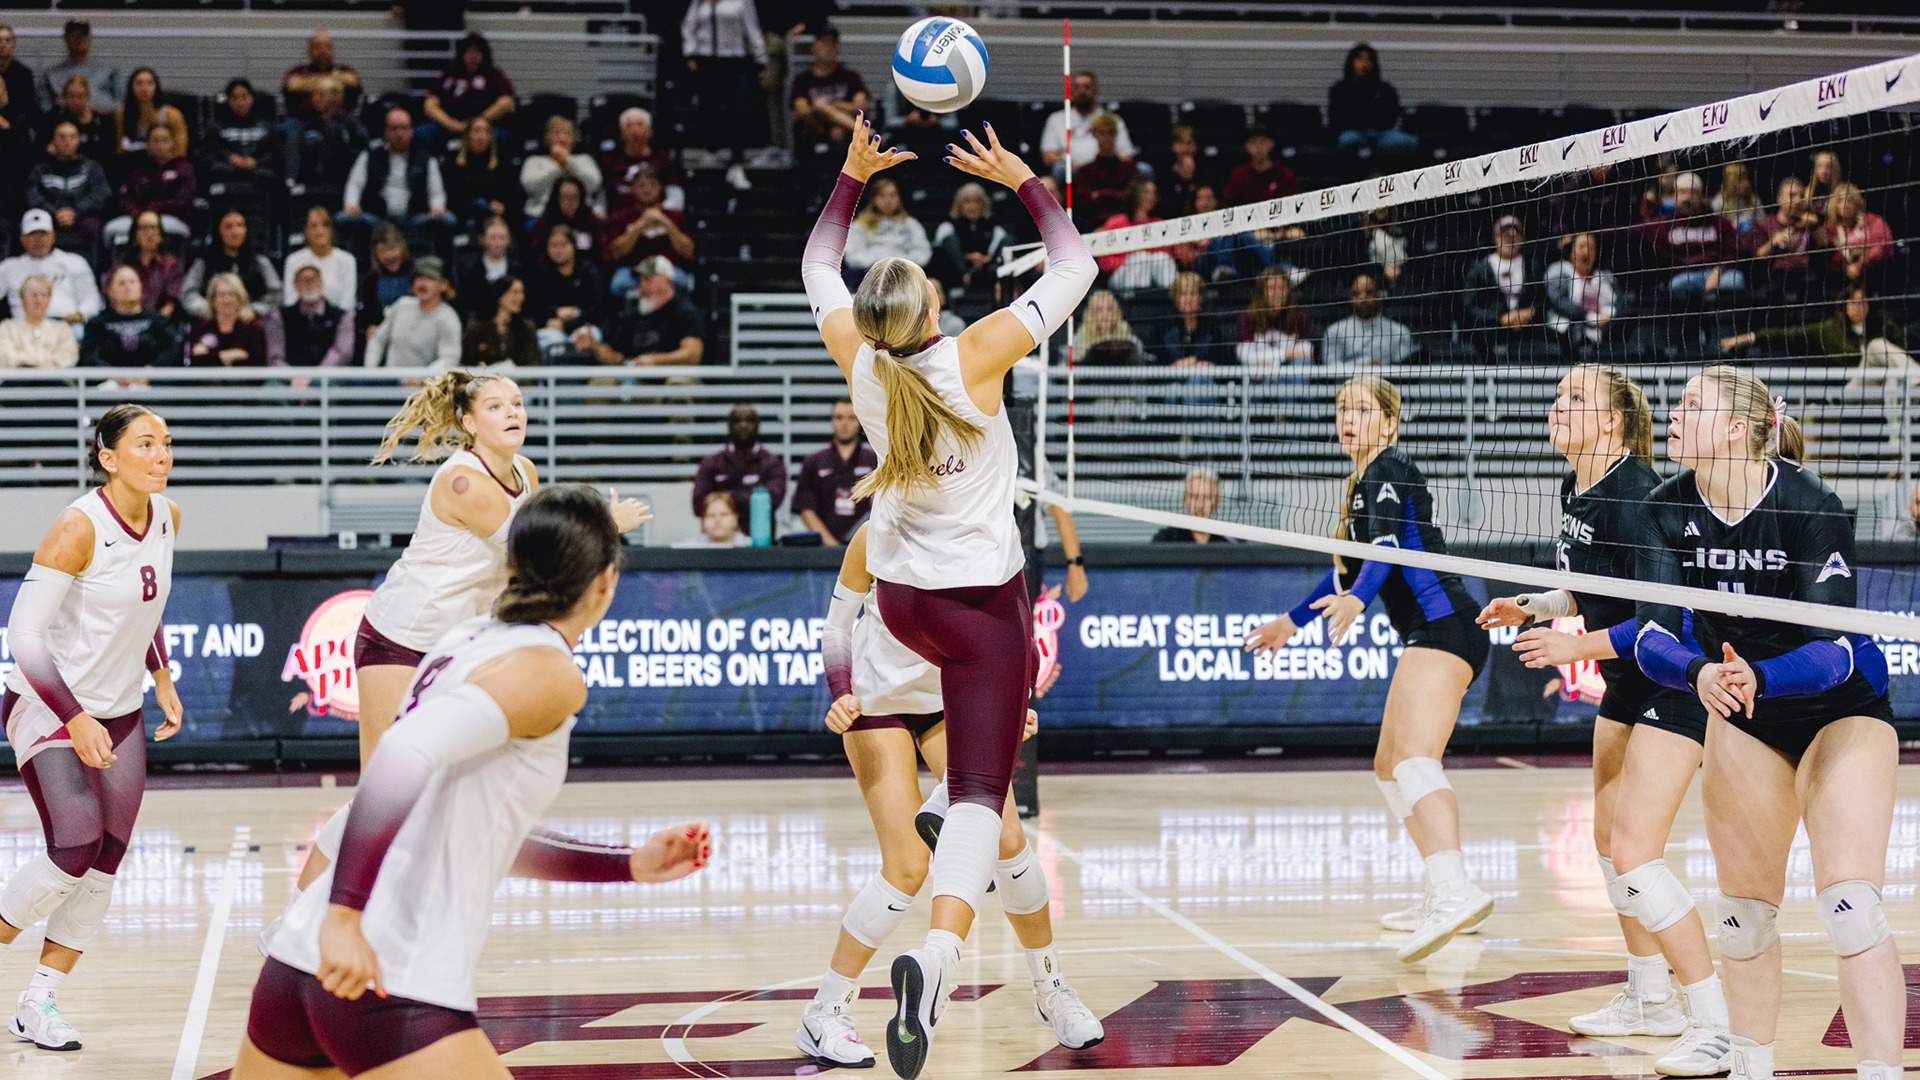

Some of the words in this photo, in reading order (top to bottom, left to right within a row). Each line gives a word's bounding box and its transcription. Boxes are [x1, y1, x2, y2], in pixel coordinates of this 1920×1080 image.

[1519, 144, 1540, 166] EKU
[1602, 124, 1627, 147] EKU
[1702, 103, 1729, 128] EKU
[1818, 75, 1847, 102] EKU
[140, 565, 157, 602] 8
[201, 623, 264, 657] AND
[573, 619, 700, 653] LECTION
[706, 619, 746, 651] OF
[751, 618, 825, 651] CRAF
[1079, 615, 1171, 648] GREAT
[628, 653, 722, 688] BEERS
[726, 653, 768, 687] ON
[773, 653, 825, 686] TAP
[1159, 648, 1250, 681] LOCAL
[1253, 647, 1343, 680] BEERS
[1347, 647, 1389, 680] ON
